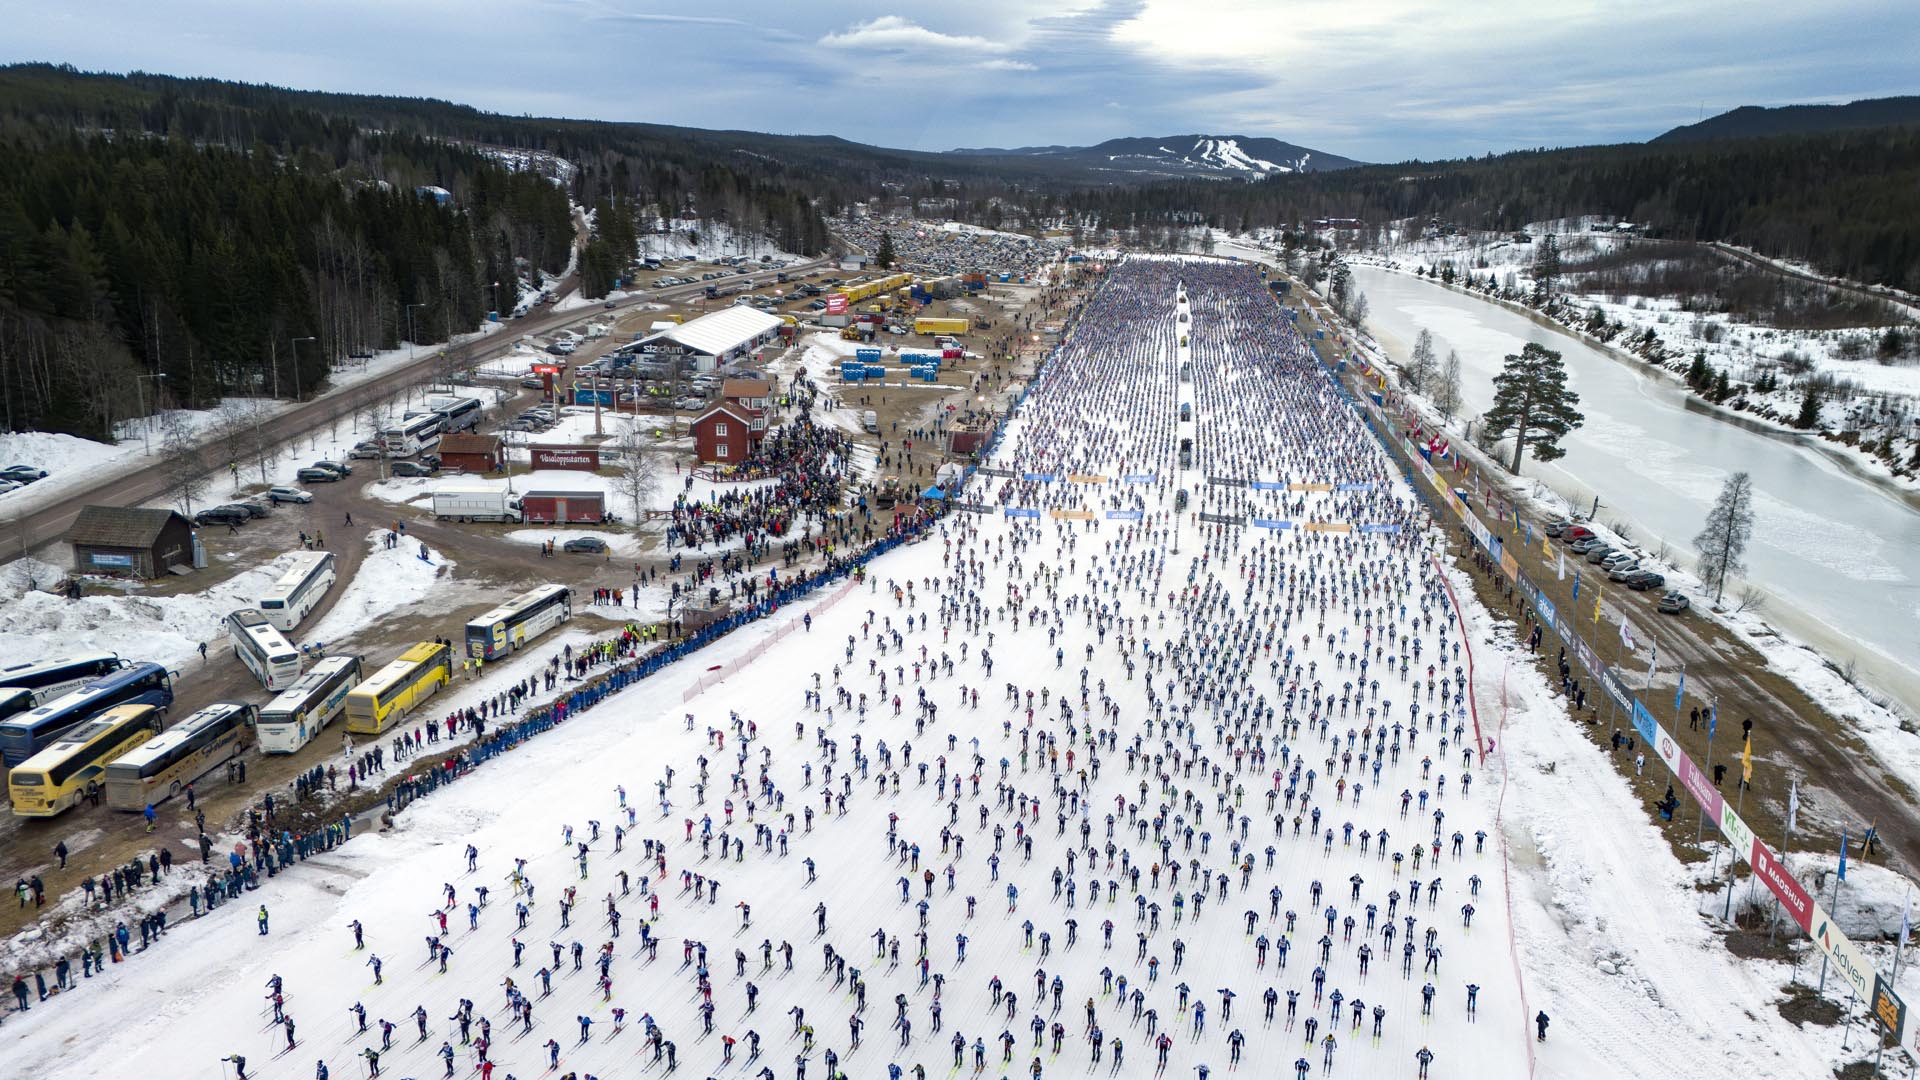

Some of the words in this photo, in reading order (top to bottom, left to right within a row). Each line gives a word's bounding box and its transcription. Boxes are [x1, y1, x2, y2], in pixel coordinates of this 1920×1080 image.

[540, 453, 591, 466] Vasaloppsstarten
[51, 680, 82, 692] connect
[1688, 763, 1713, 805] Folksam
[1768, 867, 1805, 913] MADSHUS
[1832, 943, 1866, 992] Adven
